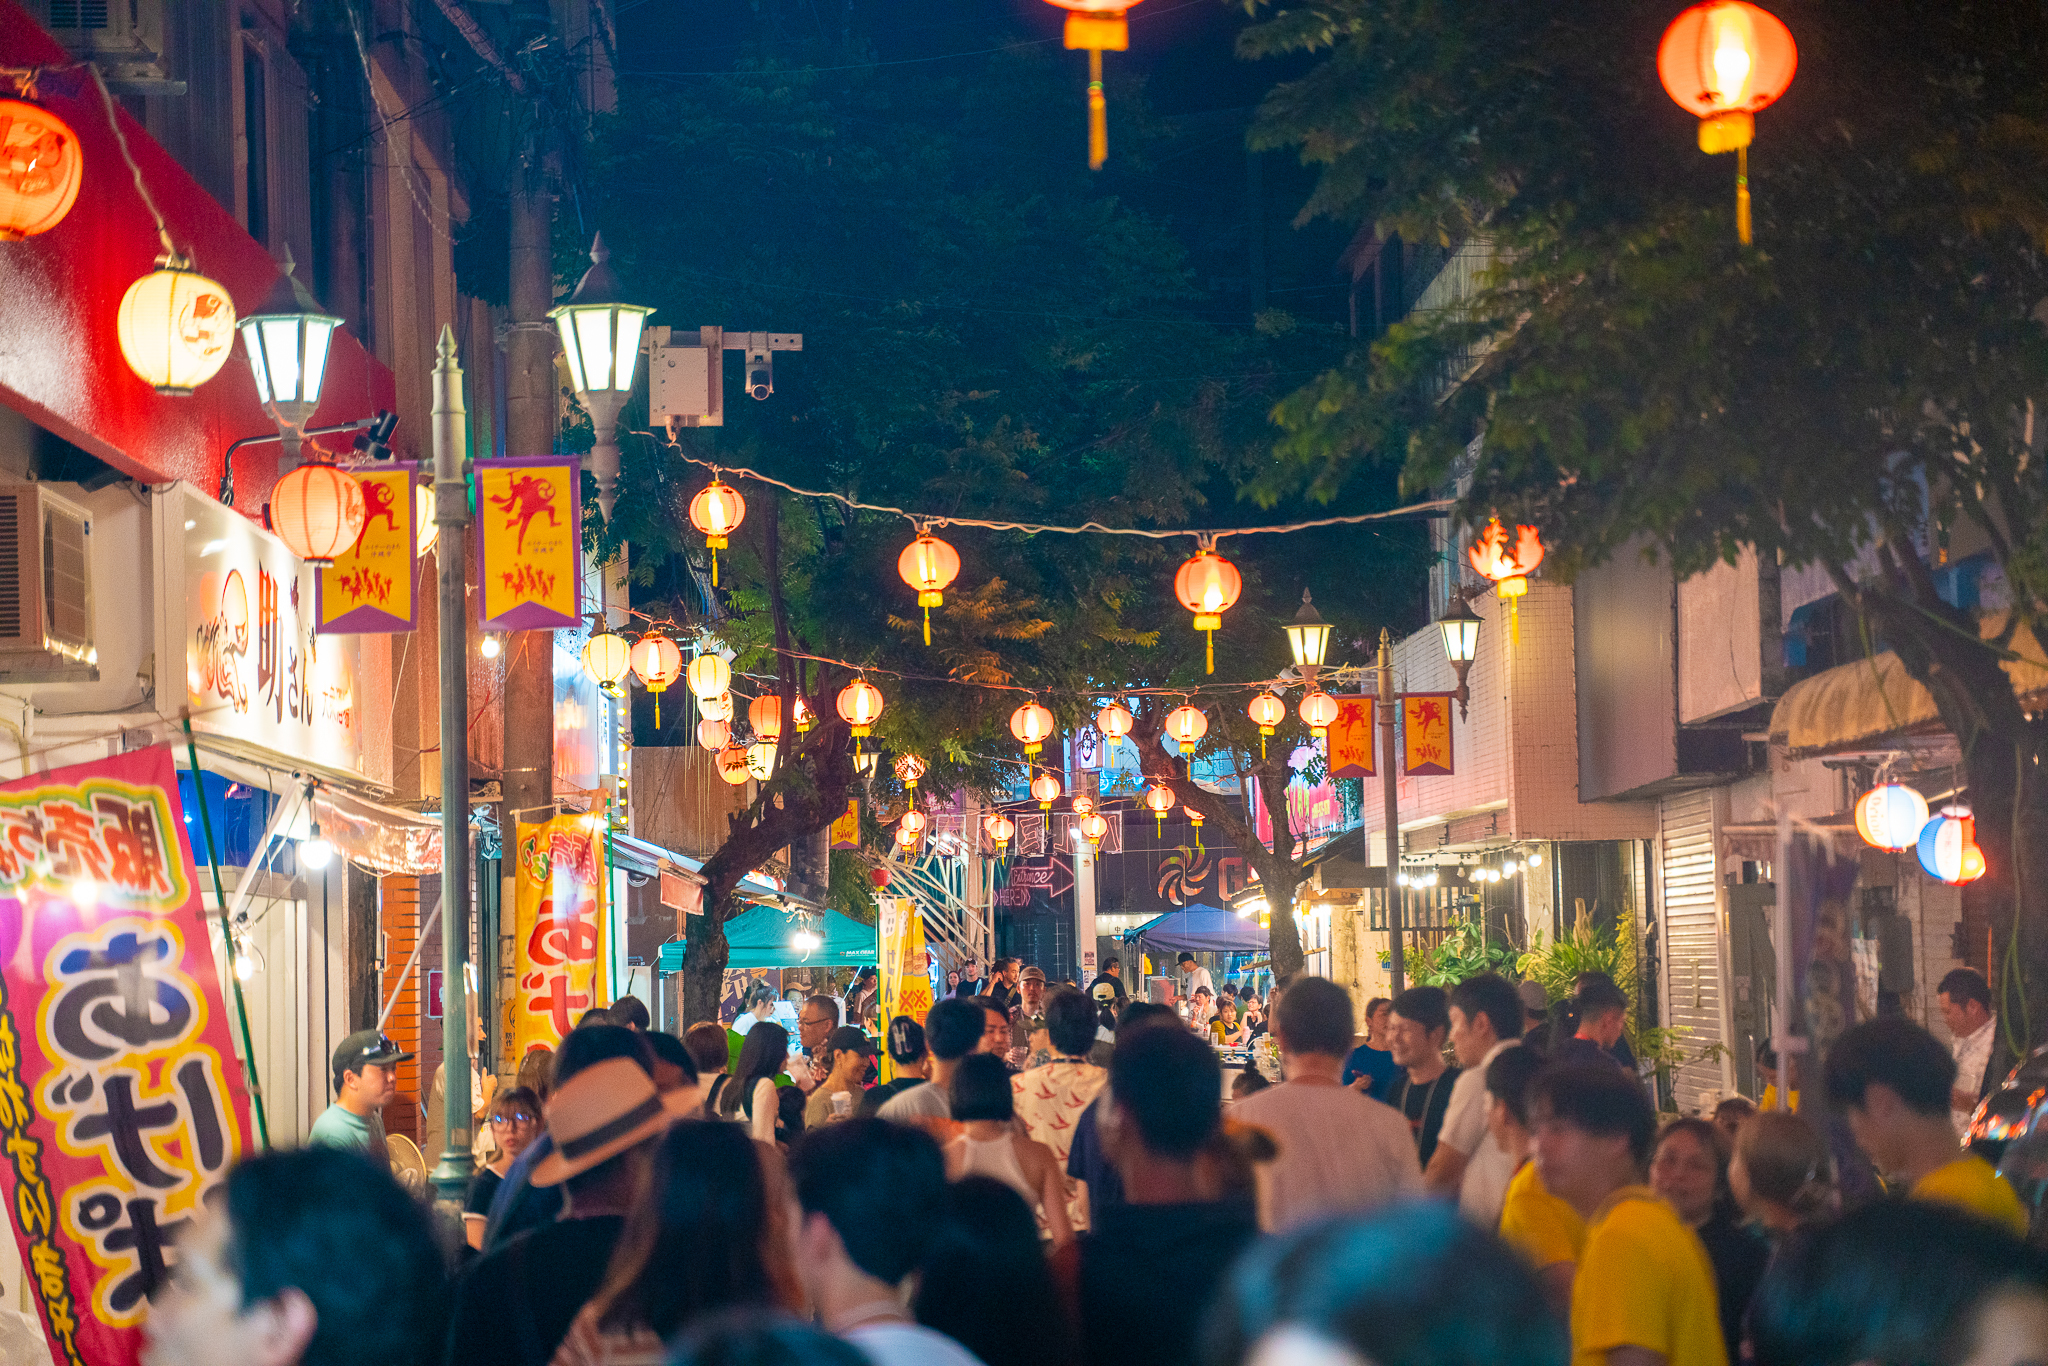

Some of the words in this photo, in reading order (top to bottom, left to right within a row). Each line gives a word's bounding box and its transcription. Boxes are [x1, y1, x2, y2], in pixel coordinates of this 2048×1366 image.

[371, 550, 392, 558] 沖縄市
[1013, 868, 1055, 884] Entrance
[999, 888, 1021, 906] HERE
